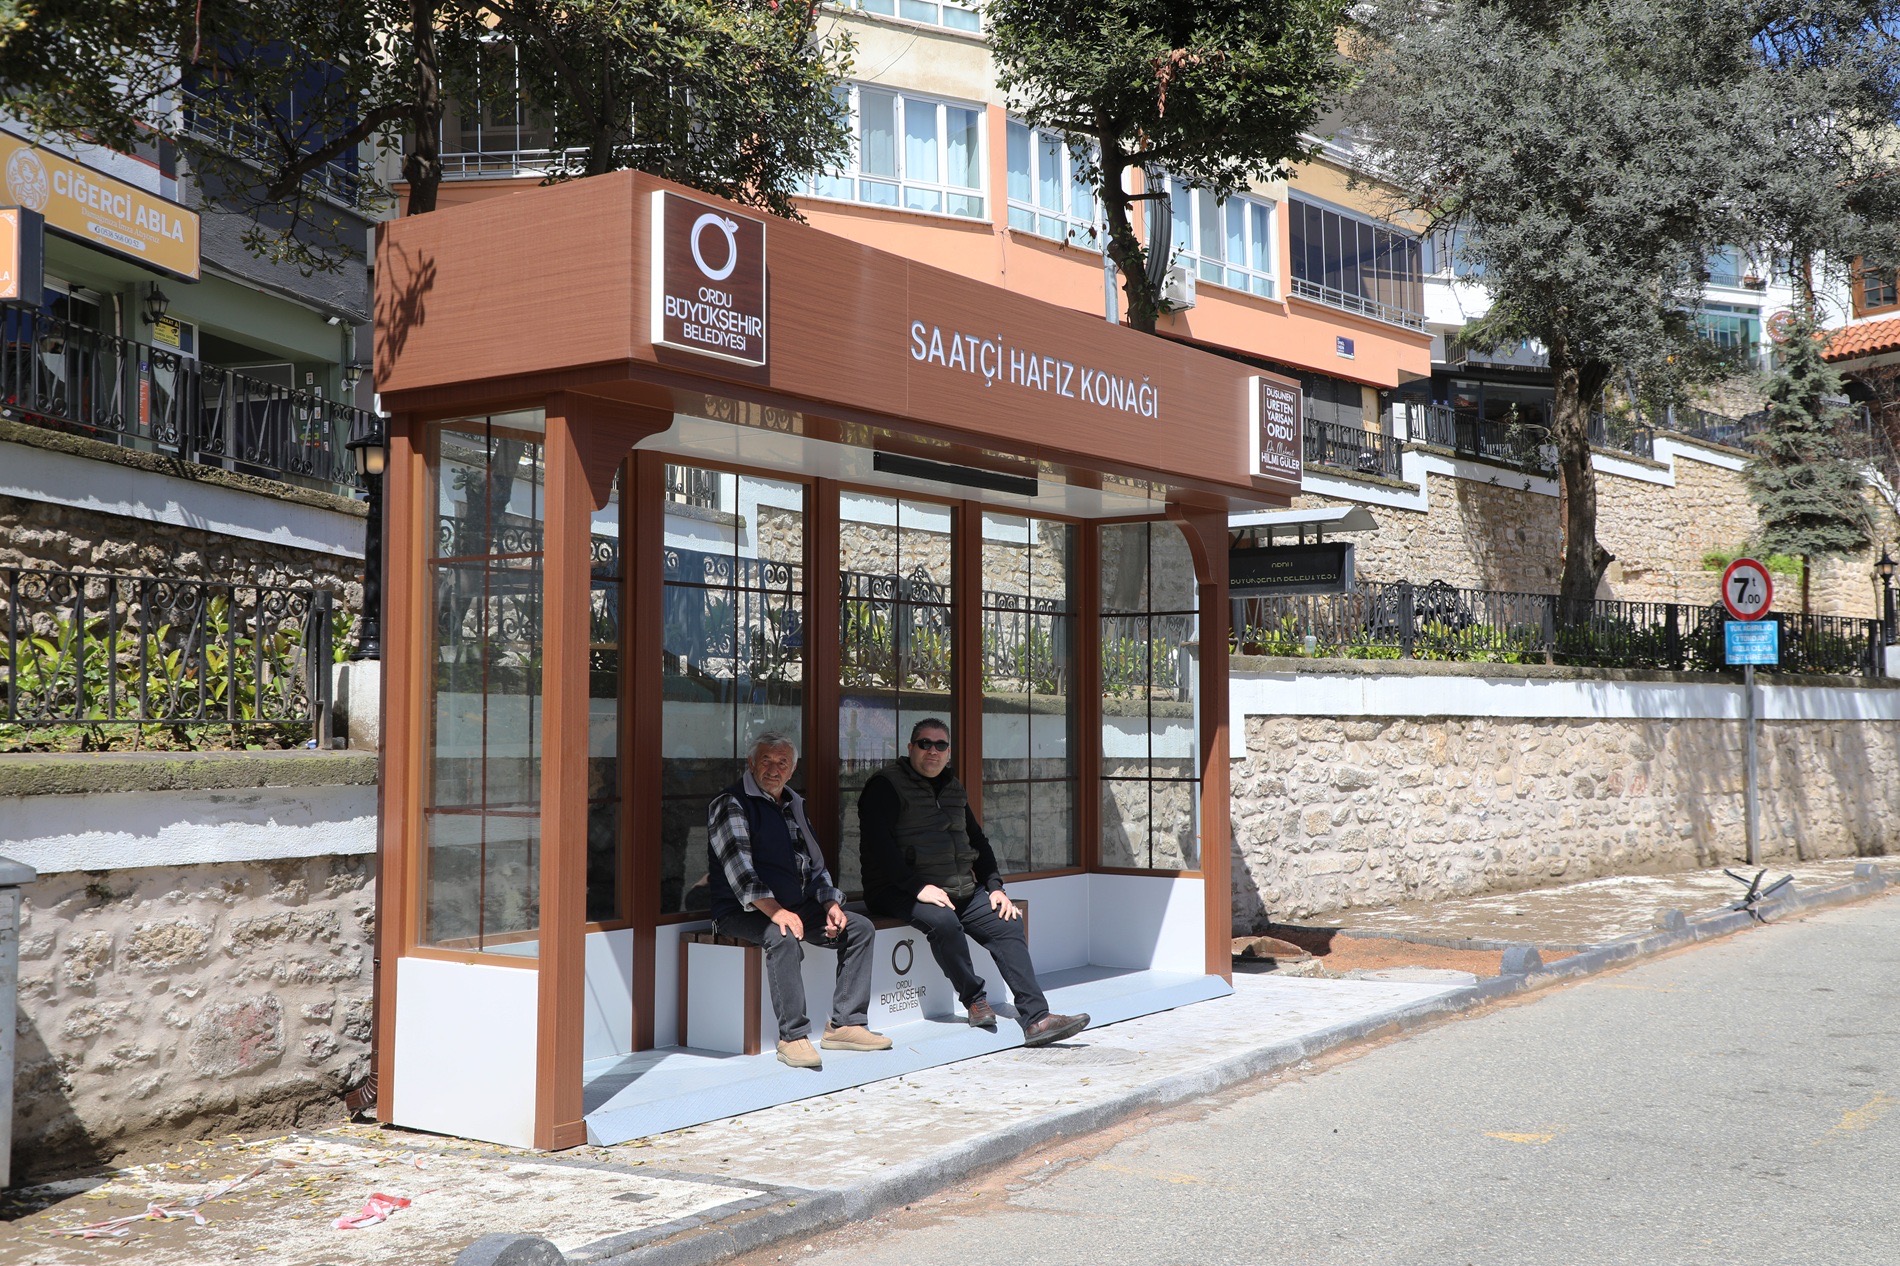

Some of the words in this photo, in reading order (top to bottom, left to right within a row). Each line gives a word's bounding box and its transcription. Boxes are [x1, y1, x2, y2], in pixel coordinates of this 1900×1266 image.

[53, 169, 131, 222] CİĞERCİ
[135, 205, 184, 243] ABLA
[698, 286, 732, 308] ORDU
[665, 294, 762, 338] BÜYÜKŞEHİR
[683, 322, 746, 351] BELEDİYESİ
[910, 319, 1003, 388] SAATÇİ
[1010, 346, 1075, 398] HAFIZ
[1081, 365, 1158, 419] KONAĞI
[1267, 423, 1293, 442] ORDU
[1279, 455, 1300, 470] GÜLER
[880, 985, 927, 1006] BÜYÜKŞEHİR
[896, 980, 912, 990] ORDU
[889, 999, 919, 1014] BELEDİYESİ
